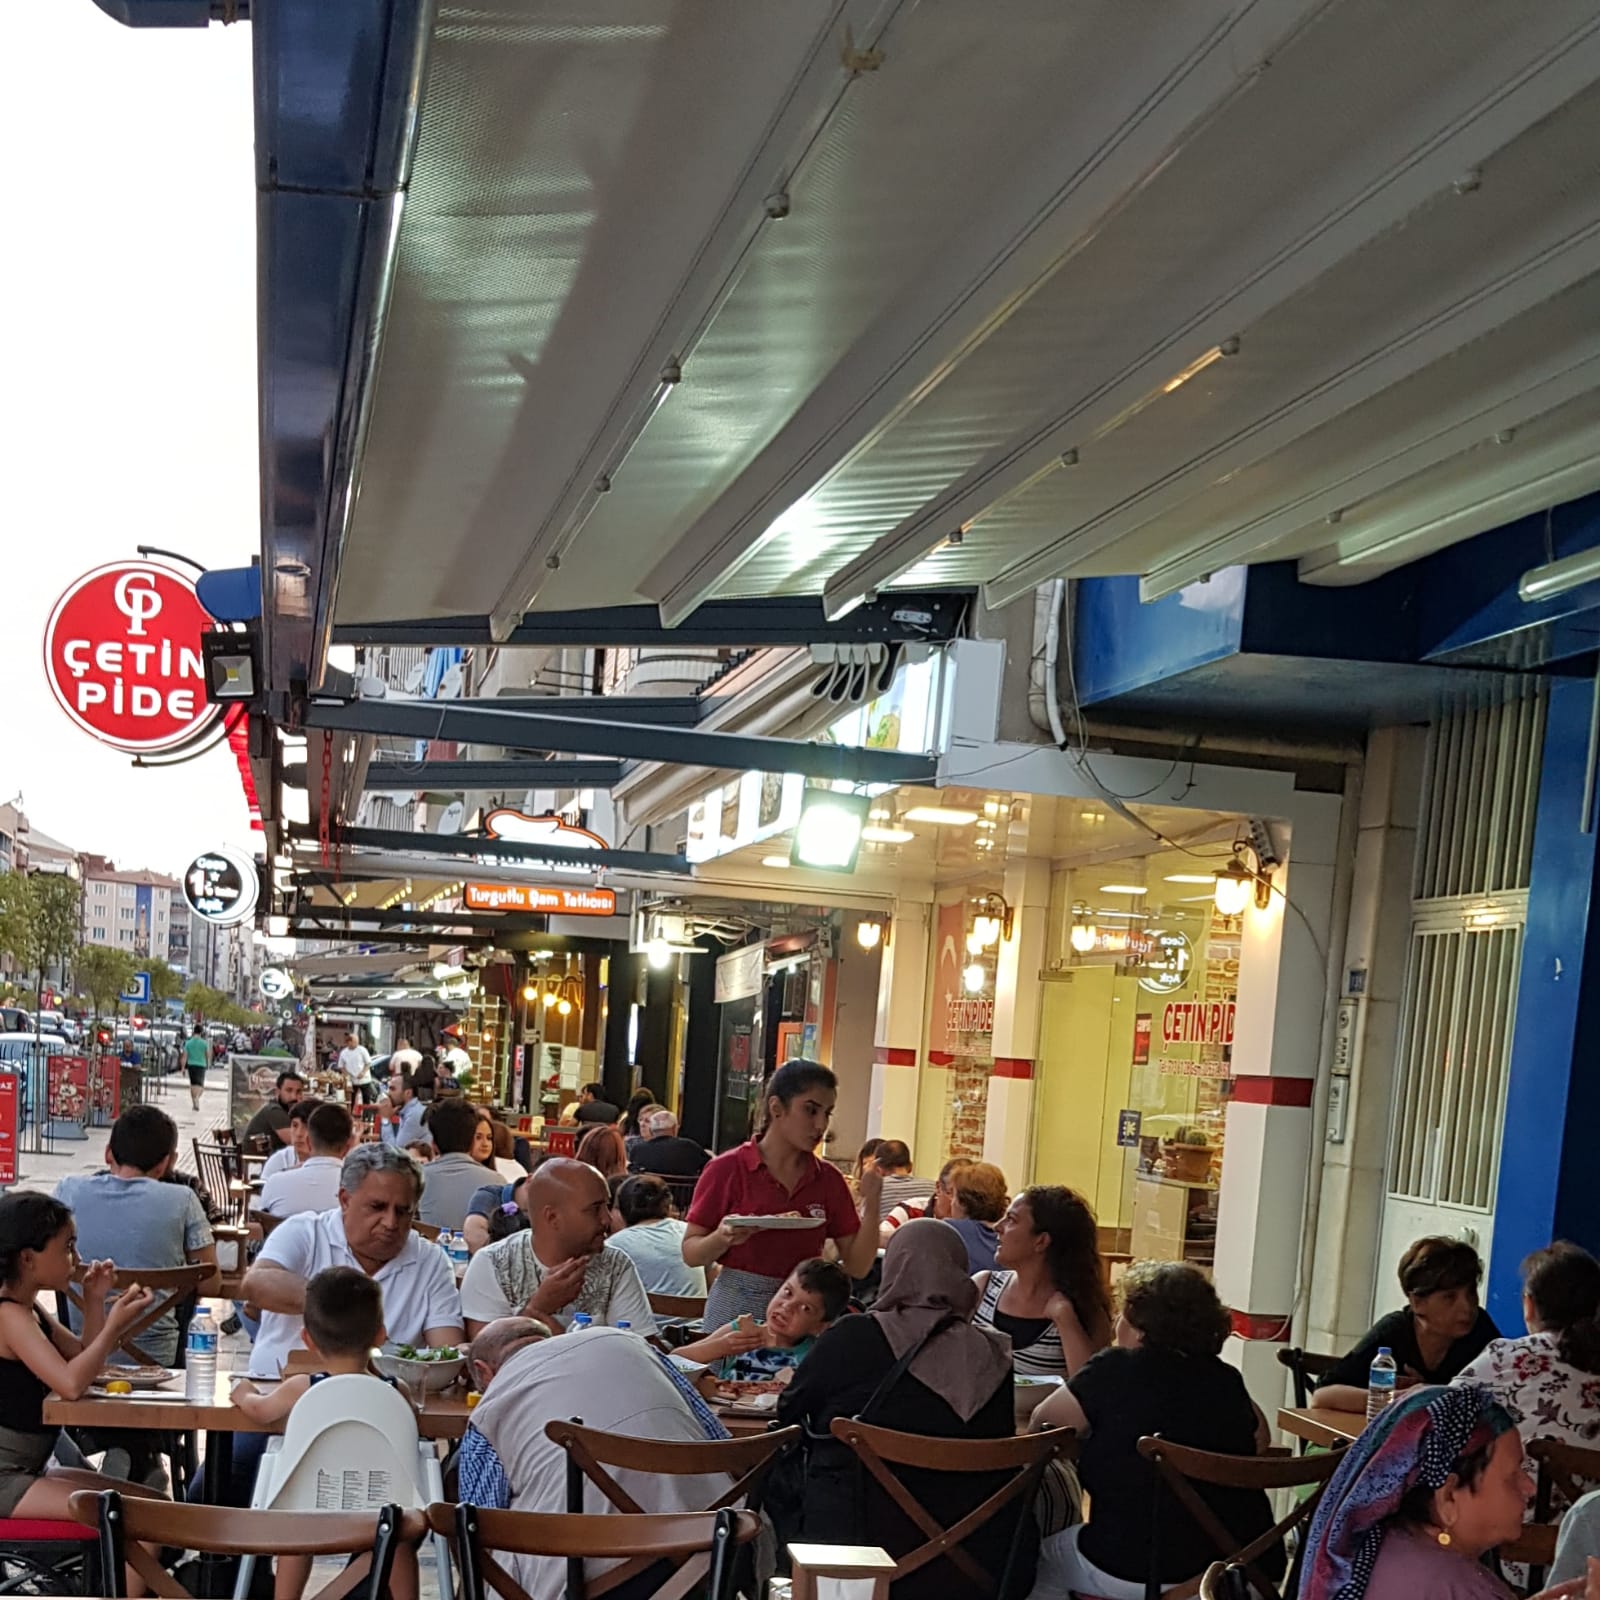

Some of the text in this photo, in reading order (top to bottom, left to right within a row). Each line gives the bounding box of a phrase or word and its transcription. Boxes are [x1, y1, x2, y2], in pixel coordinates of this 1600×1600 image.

[63, 638, 205, 679] ÇETİN
[77, 677, 194, 720] PİDE
[1162, 990, 1236, 1053] ÇETİN PİD
